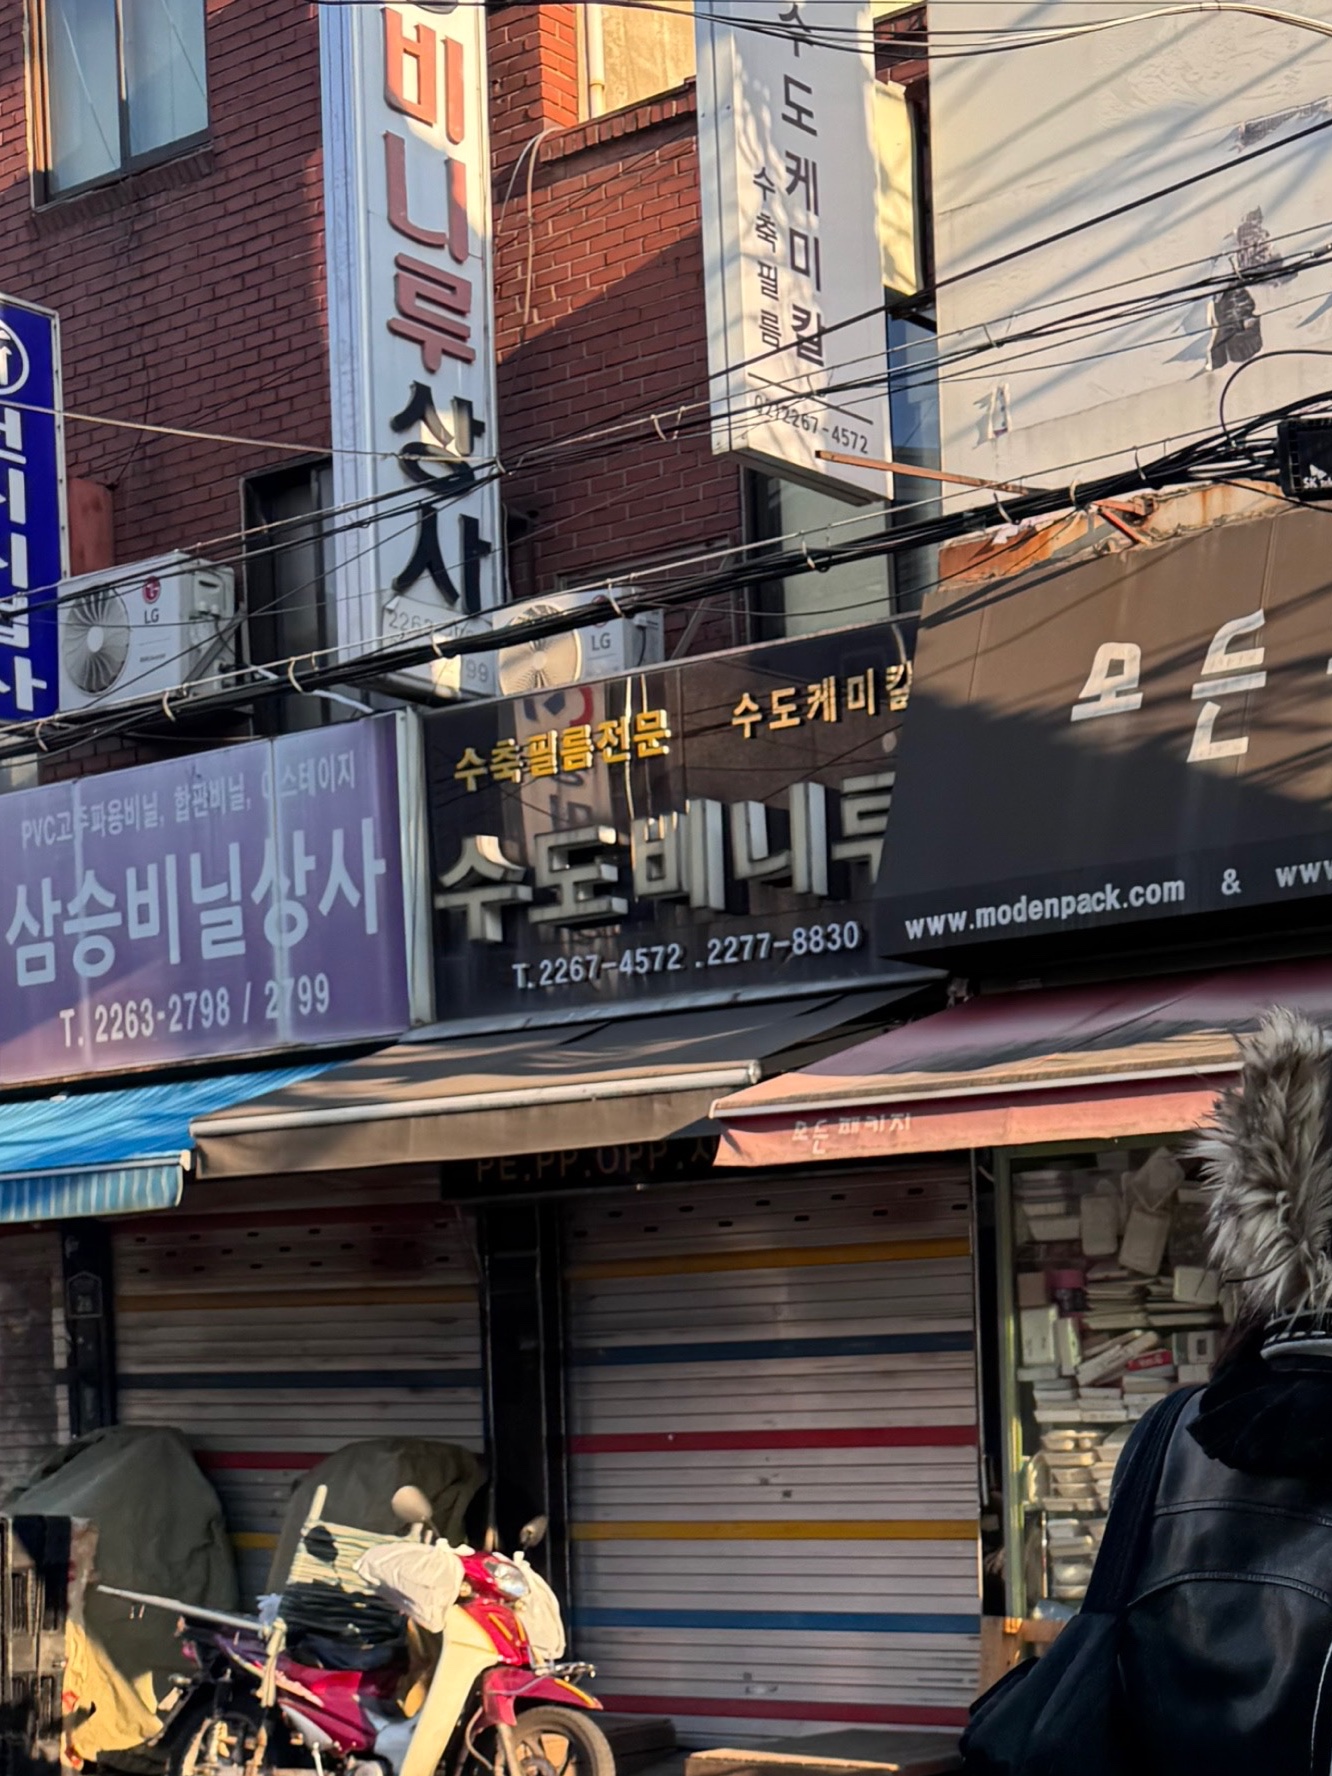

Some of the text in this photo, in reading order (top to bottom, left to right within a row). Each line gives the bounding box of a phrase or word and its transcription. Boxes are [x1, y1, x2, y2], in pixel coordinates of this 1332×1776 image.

[778, 2, 825, 367] 수도케미칼
[753, 167, 783, 350] 수축필름
[1303, 476, 1318, 489] SK
[144, 608, 160, 624] LG
[590, 632, 612, 651] LG
[6, 817, 387, 988] 삼승비닐상사
[904, 877, 1185, 941] www.modenpack.com
[1220, 868, 1241, 896] &
[59, 1008, 84, 1048] T.
[94, 986, 231, 1045] 2263-2798
[264, 973, 330, 1020] 2799
